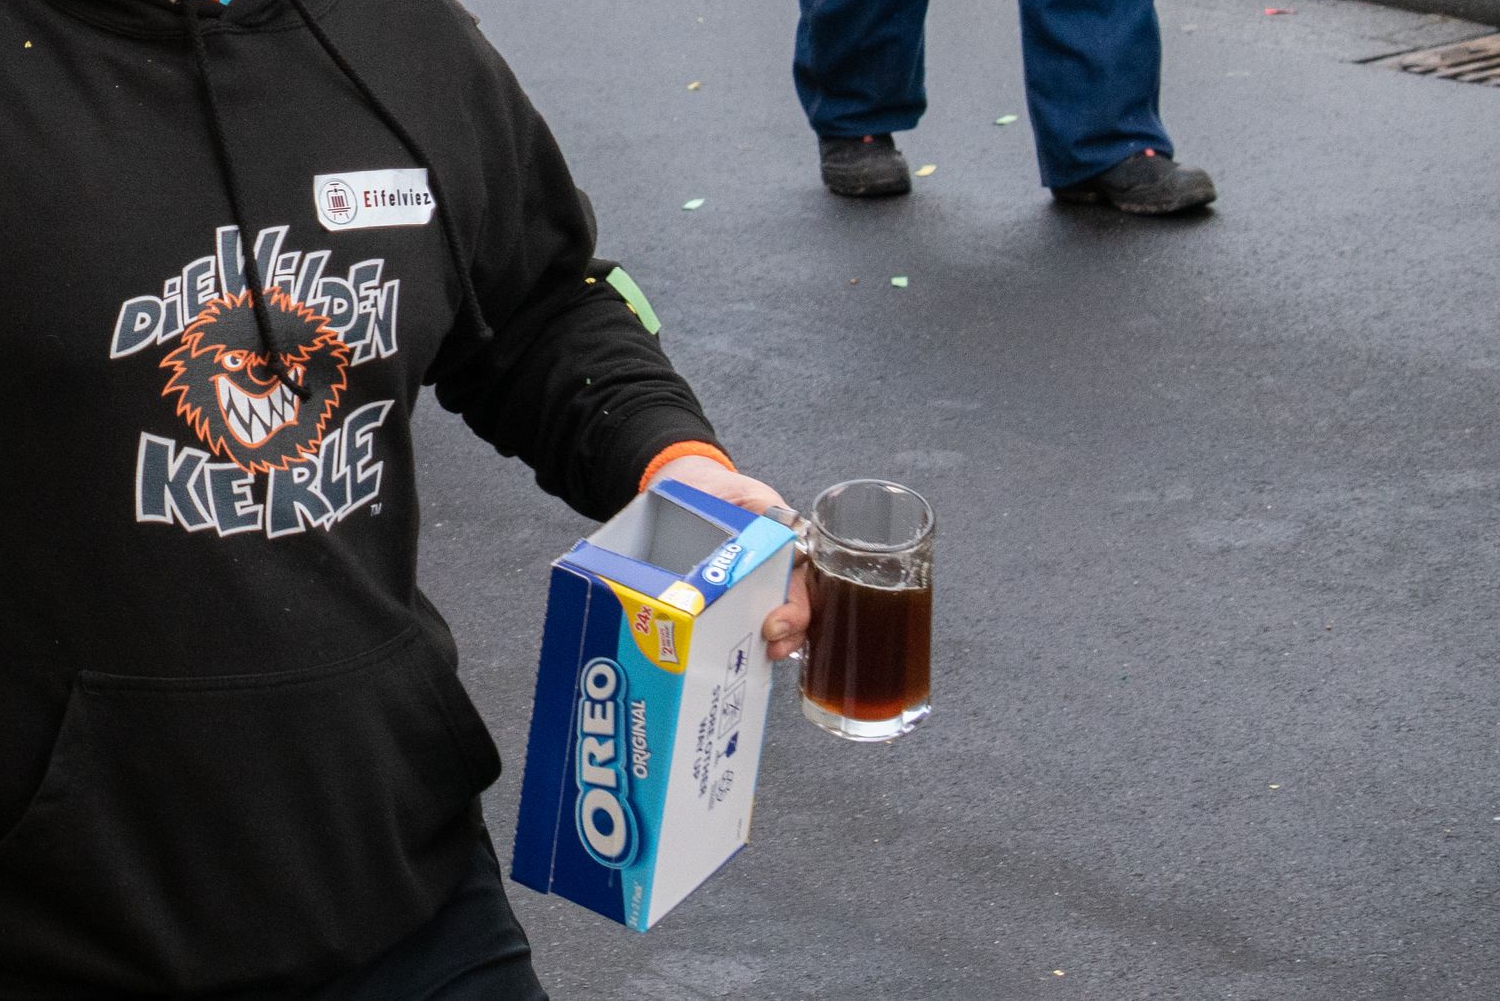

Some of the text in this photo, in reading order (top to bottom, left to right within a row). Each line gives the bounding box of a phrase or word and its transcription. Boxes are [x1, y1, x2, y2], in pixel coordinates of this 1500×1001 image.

[363, 188, 432, 208] Eifelviez
[135, 399, 395, 539] KERLE
[703, 542, 743, 583] OREO
[634, 605, 653, 635] 24x
[580, 661, 629, 860] OREO
[630, 699, 649, 780] ORIGINAL
